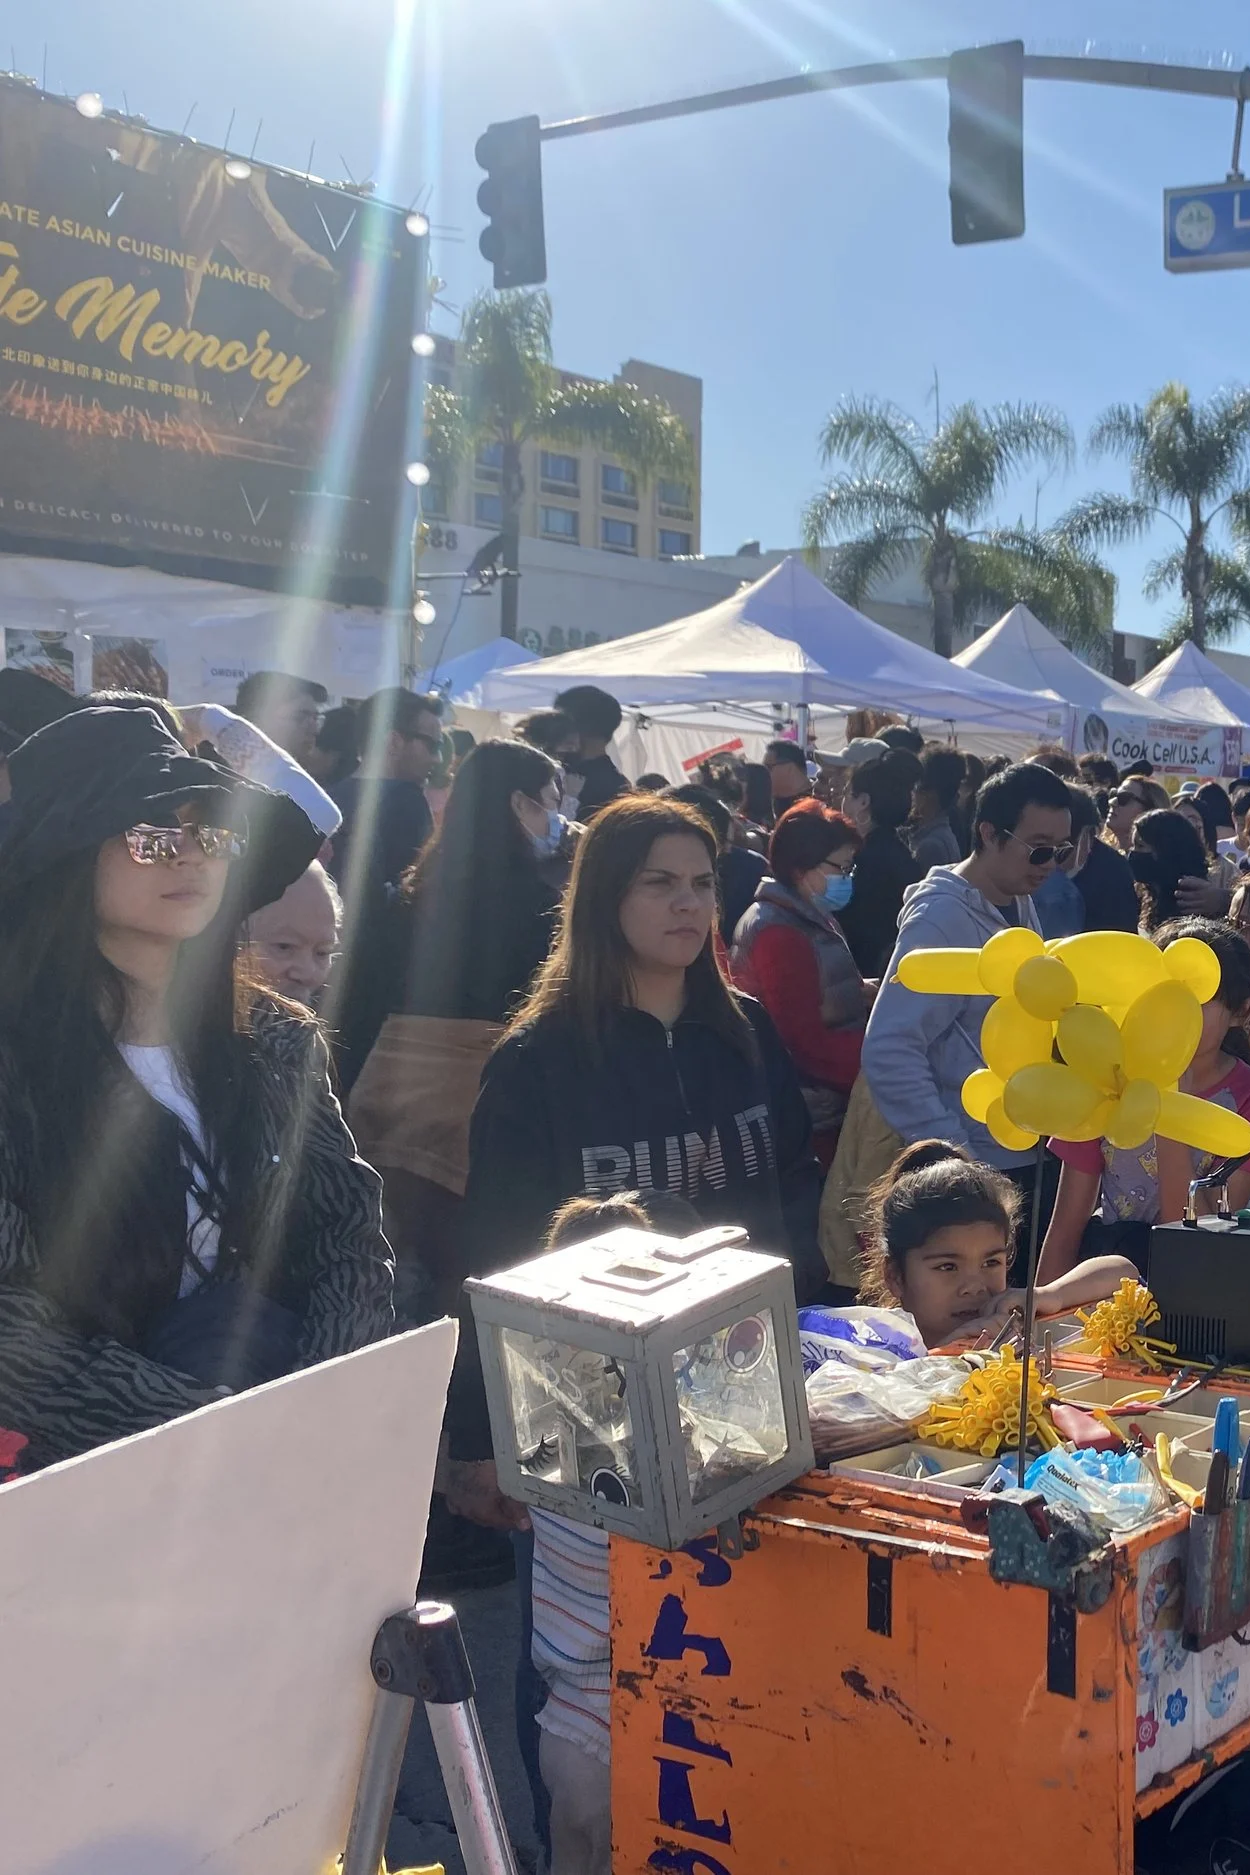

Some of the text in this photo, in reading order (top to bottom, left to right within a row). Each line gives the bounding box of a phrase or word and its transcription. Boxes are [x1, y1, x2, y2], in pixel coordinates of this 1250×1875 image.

[45, 215, 113, 248] ASIAN
[116, 235, 198, 271] CUISINE
[204, 260, 272, 292] MAKER
[54, 276, 312, 407] Memory
[13, 498, 102, 522] DELICACY
[111, 511, 205, 538] DELIVERED
[212, 528, 233, 543] TO
[240, 534, 283, 551] YOUR
[1111, 736, 1148, 760] Cook
[581, 1124, 728, 1198] RUN
